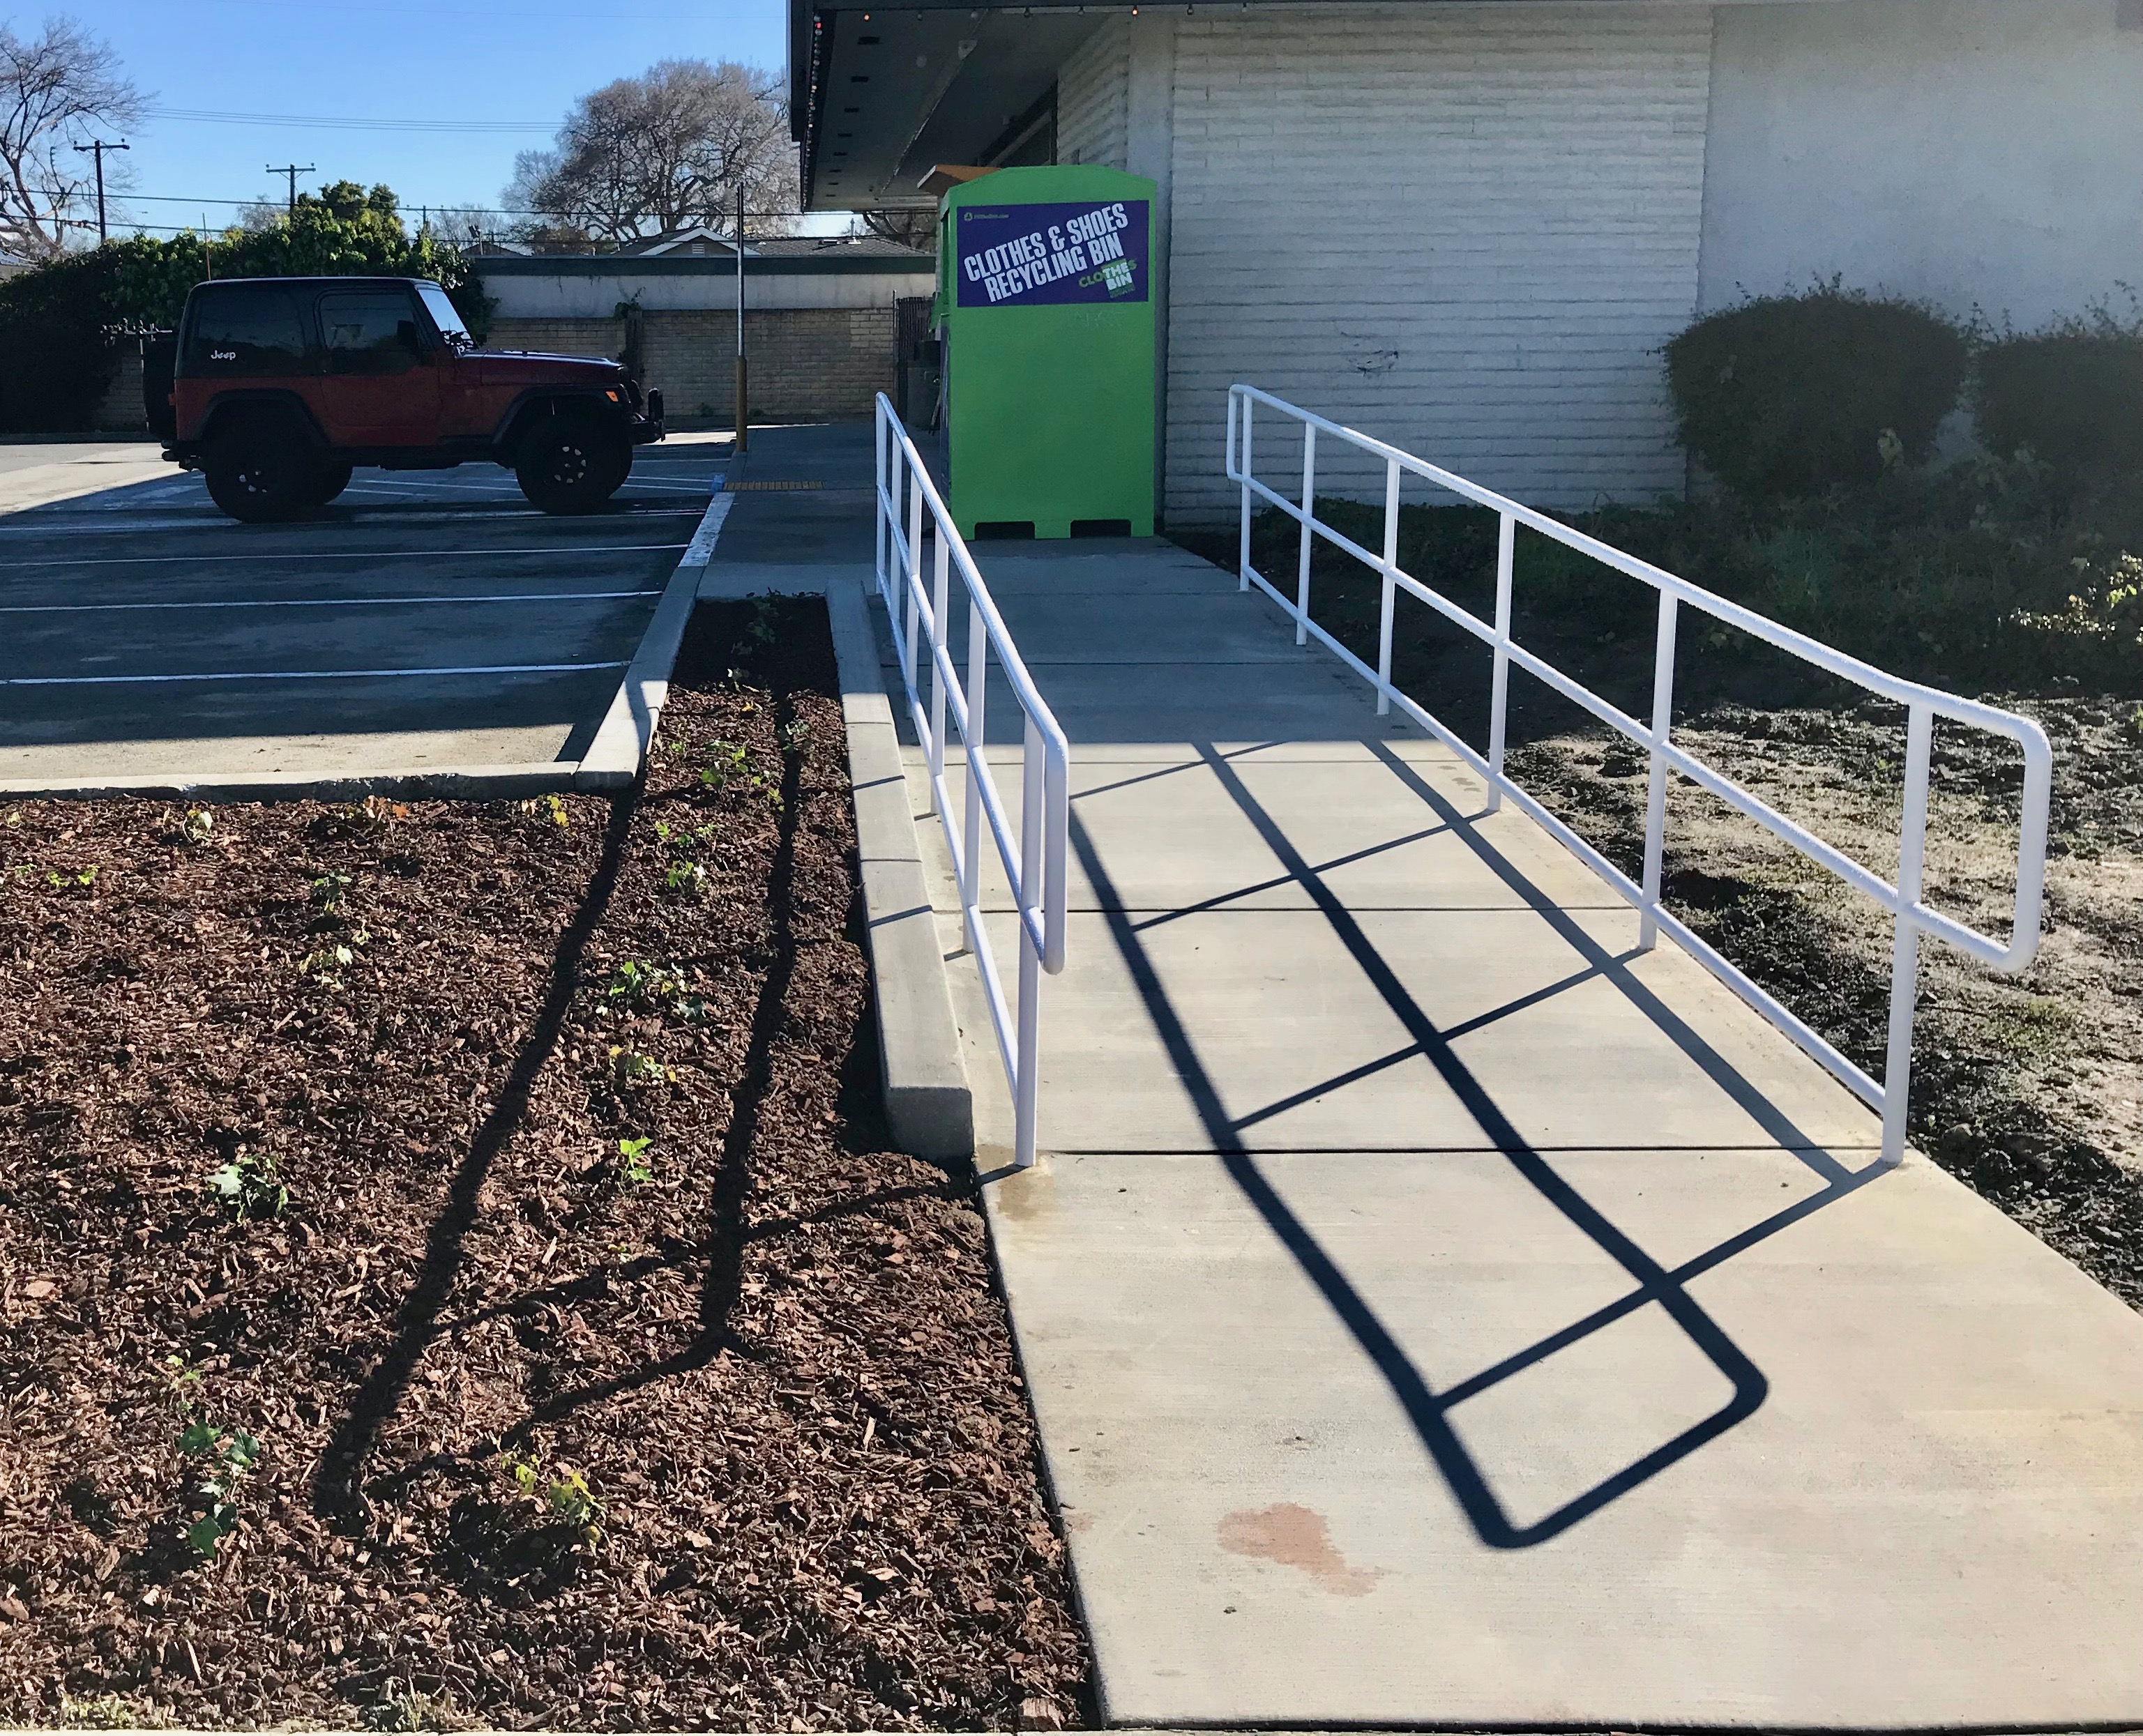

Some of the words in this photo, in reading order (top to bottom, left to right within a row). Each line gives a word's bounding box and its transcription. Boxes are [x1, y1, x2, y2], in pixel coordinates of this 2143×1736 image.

[964, 232, 1046, 282] CLOTHES
[1048, 225, 1065, 251] &
[1066, 203, 1128, 244] SHOES
[984, 246, 1088, 303] RECYCLING
[1087, 231, 1124, 266] BIN
[1105, 272, 1133, 291] BIN
[211, 349, 236, 360] Jeep
